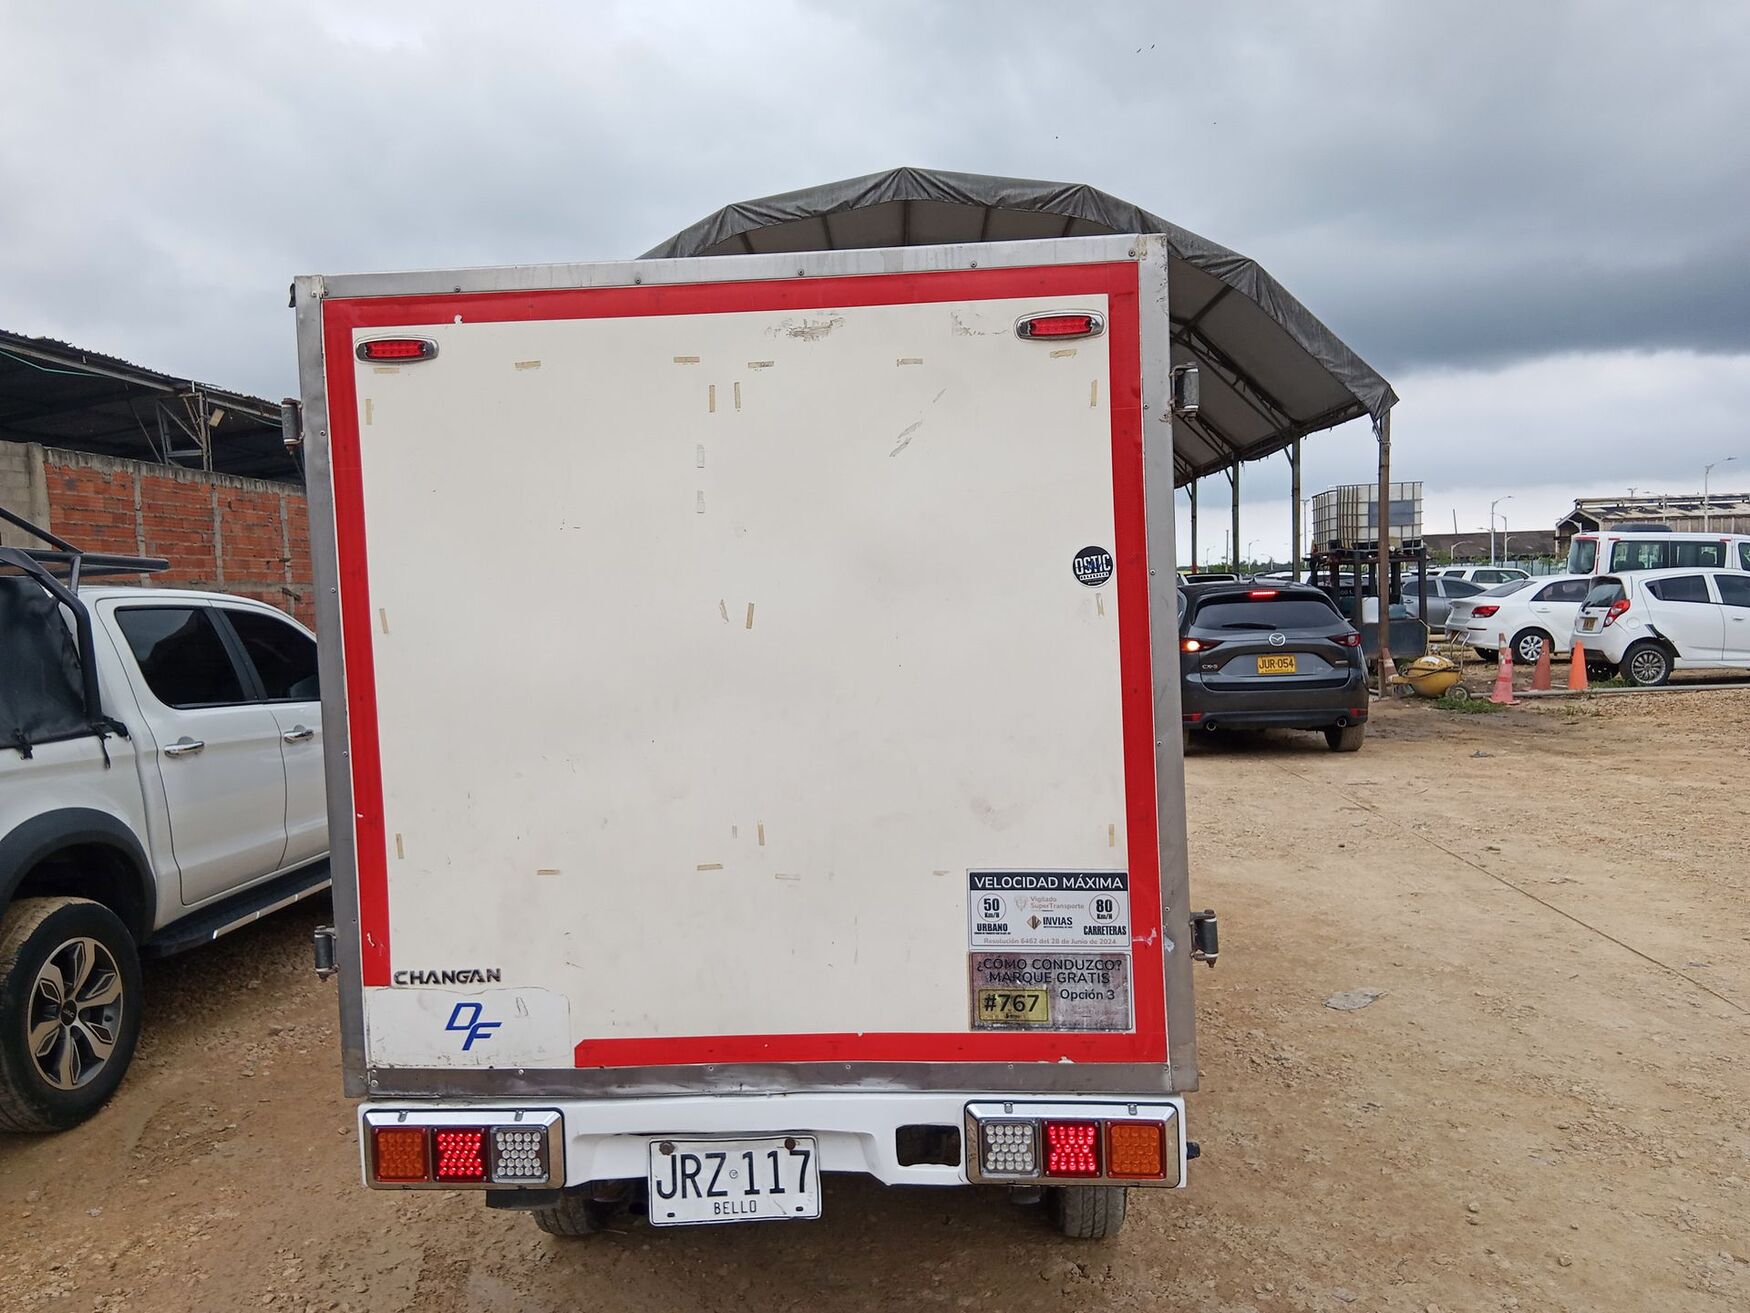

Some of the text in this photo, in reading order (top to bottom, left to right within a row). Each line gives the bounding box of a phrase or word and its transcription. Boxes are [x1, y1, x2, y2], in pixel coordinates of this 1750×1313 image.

[1074, 554, 1111, 575] OSTIC
[974, 874, 1123, 889] VELOCIDAD MÁXIMA
[983, 898, 1000, 912] 50
[1096, 899, 1113, 913] 80
[976, 923, 1008, 932] URBANO
[1043, 916, 1073, 926] INVIAS
[1083, 925, 1127, 936] CARRETERAS
[1032, 959, 1122, 971] CONDUZCO?
[393, 968, 501, 985] CHANGAN
[989, 972, 1110, 985] MARQUE GRATIS
[1060, 988, 1115, 1001] Opción 3
[984, 993, 1039, 1012] #767
[656, 1150, 811, 1199] JRZ 117
[714, 1200, 757, 1215] BELLO
